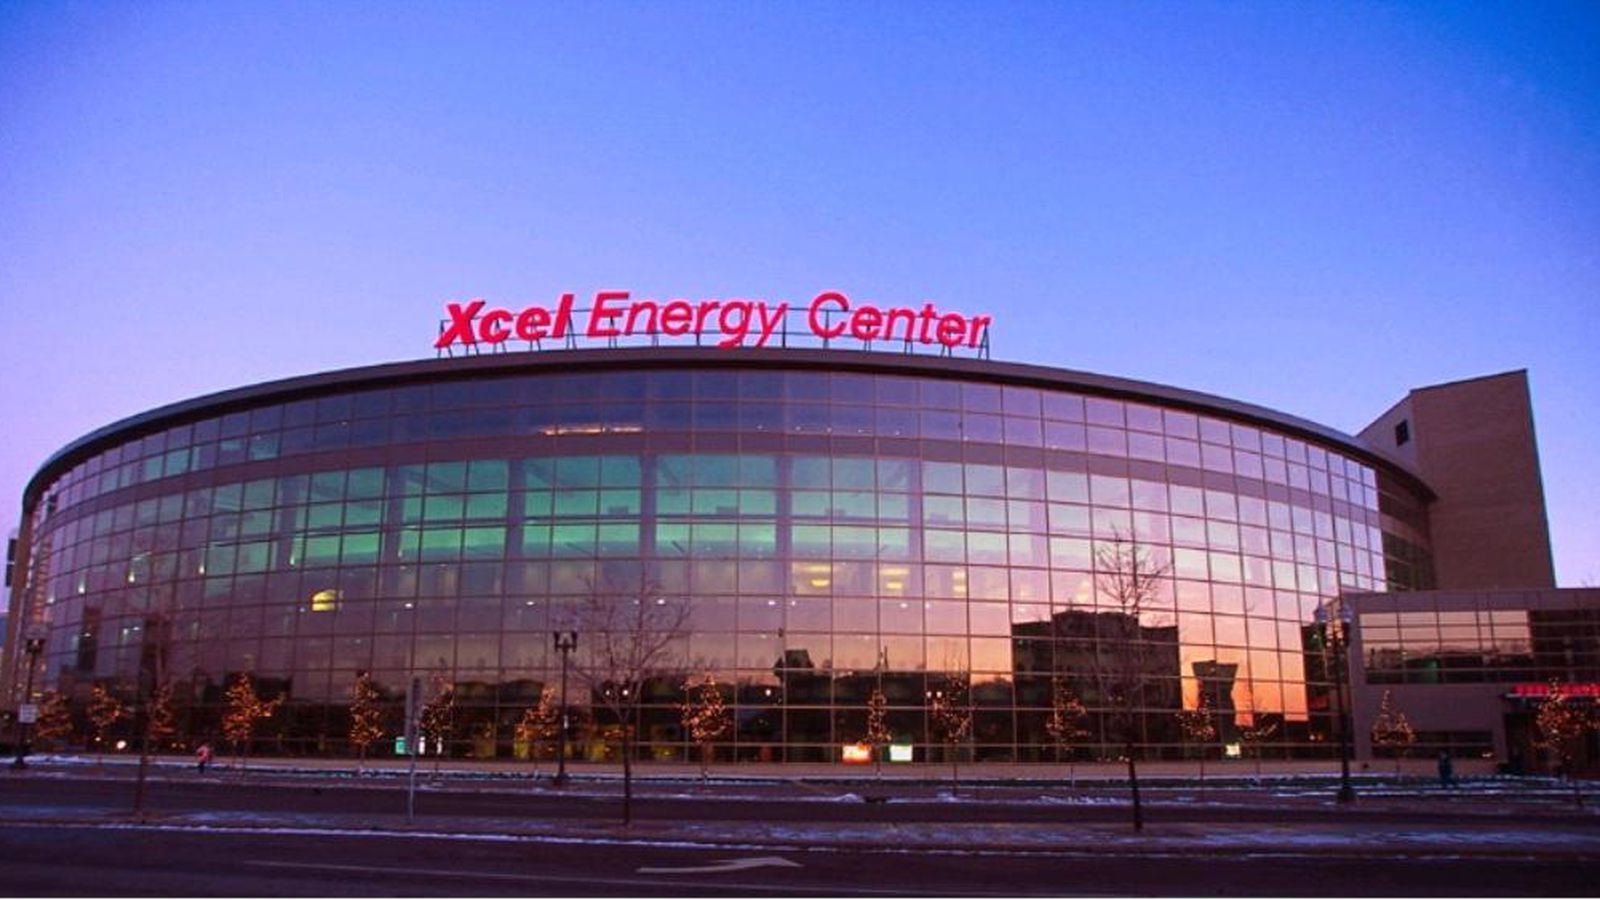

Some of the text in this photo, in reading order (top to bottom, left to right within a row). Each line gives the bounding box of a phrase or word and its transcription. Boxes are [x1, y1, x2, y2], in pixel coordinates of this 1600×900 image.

[435, 291, 991, 349] Xcel Energy Center
